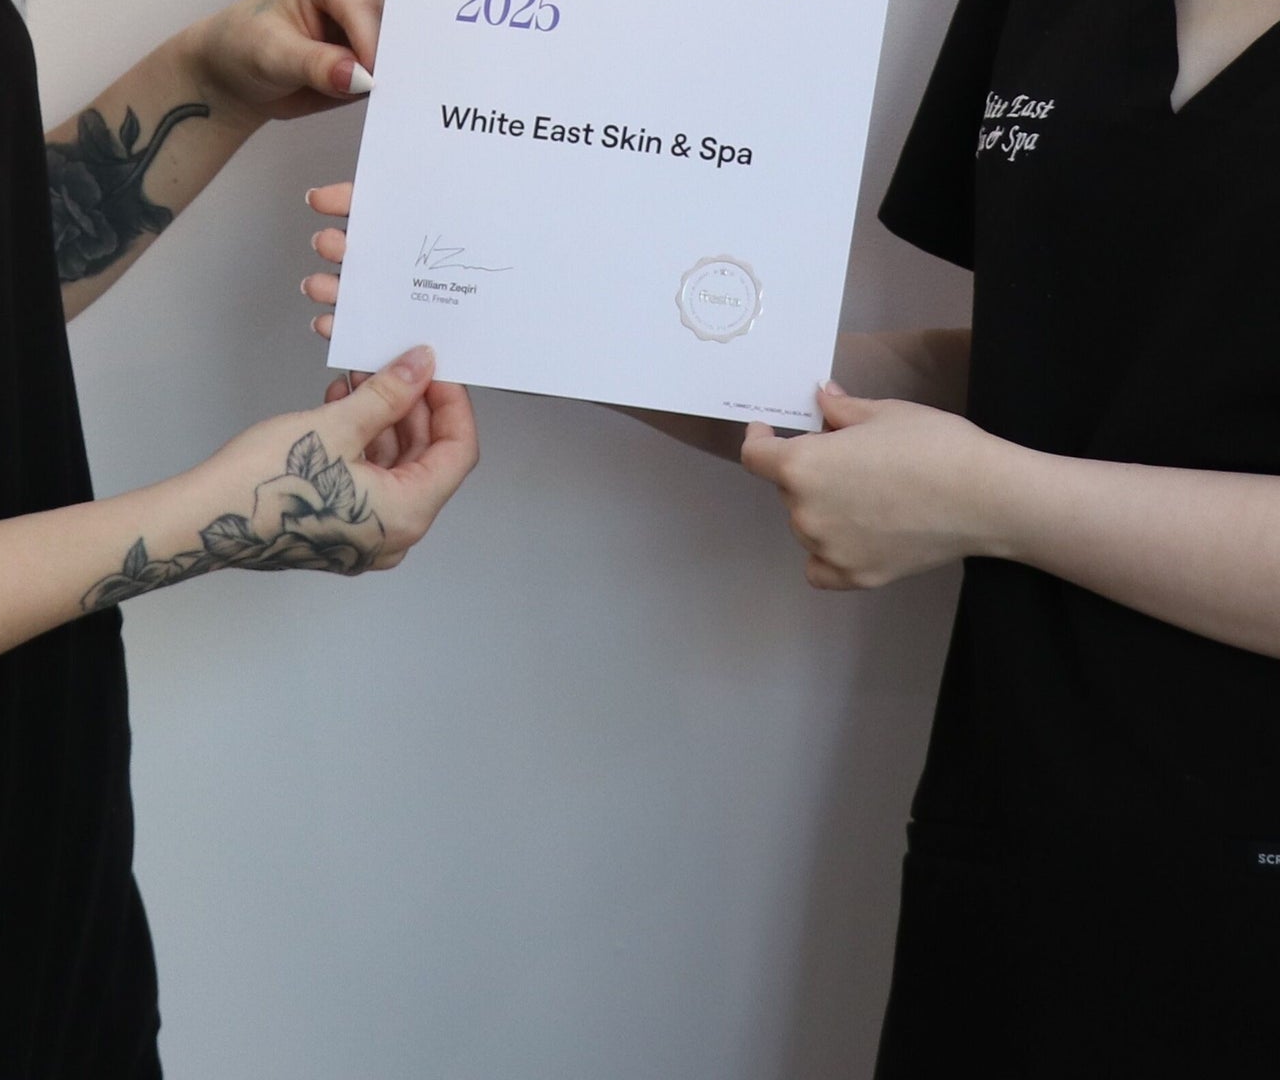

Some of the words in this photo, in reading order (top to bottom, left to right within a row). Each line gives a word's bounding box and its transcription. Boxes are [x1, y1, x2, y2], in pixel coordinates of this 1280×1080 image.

[1006, 94, 1055, 119] East
[441, 104, 525, 137] White
[532, 116, 595, 146] East
[601, 124, 662, 155] Skin
[671, 133, 692, 158] &
[699, 136, 754, 168] Spa
[1001, 125, 1040, 162] Spa
[412, 278, 447, 292] William
[449, 281, 477, 296] Zeqiri
[432, 293, 459, 306] Fresha
